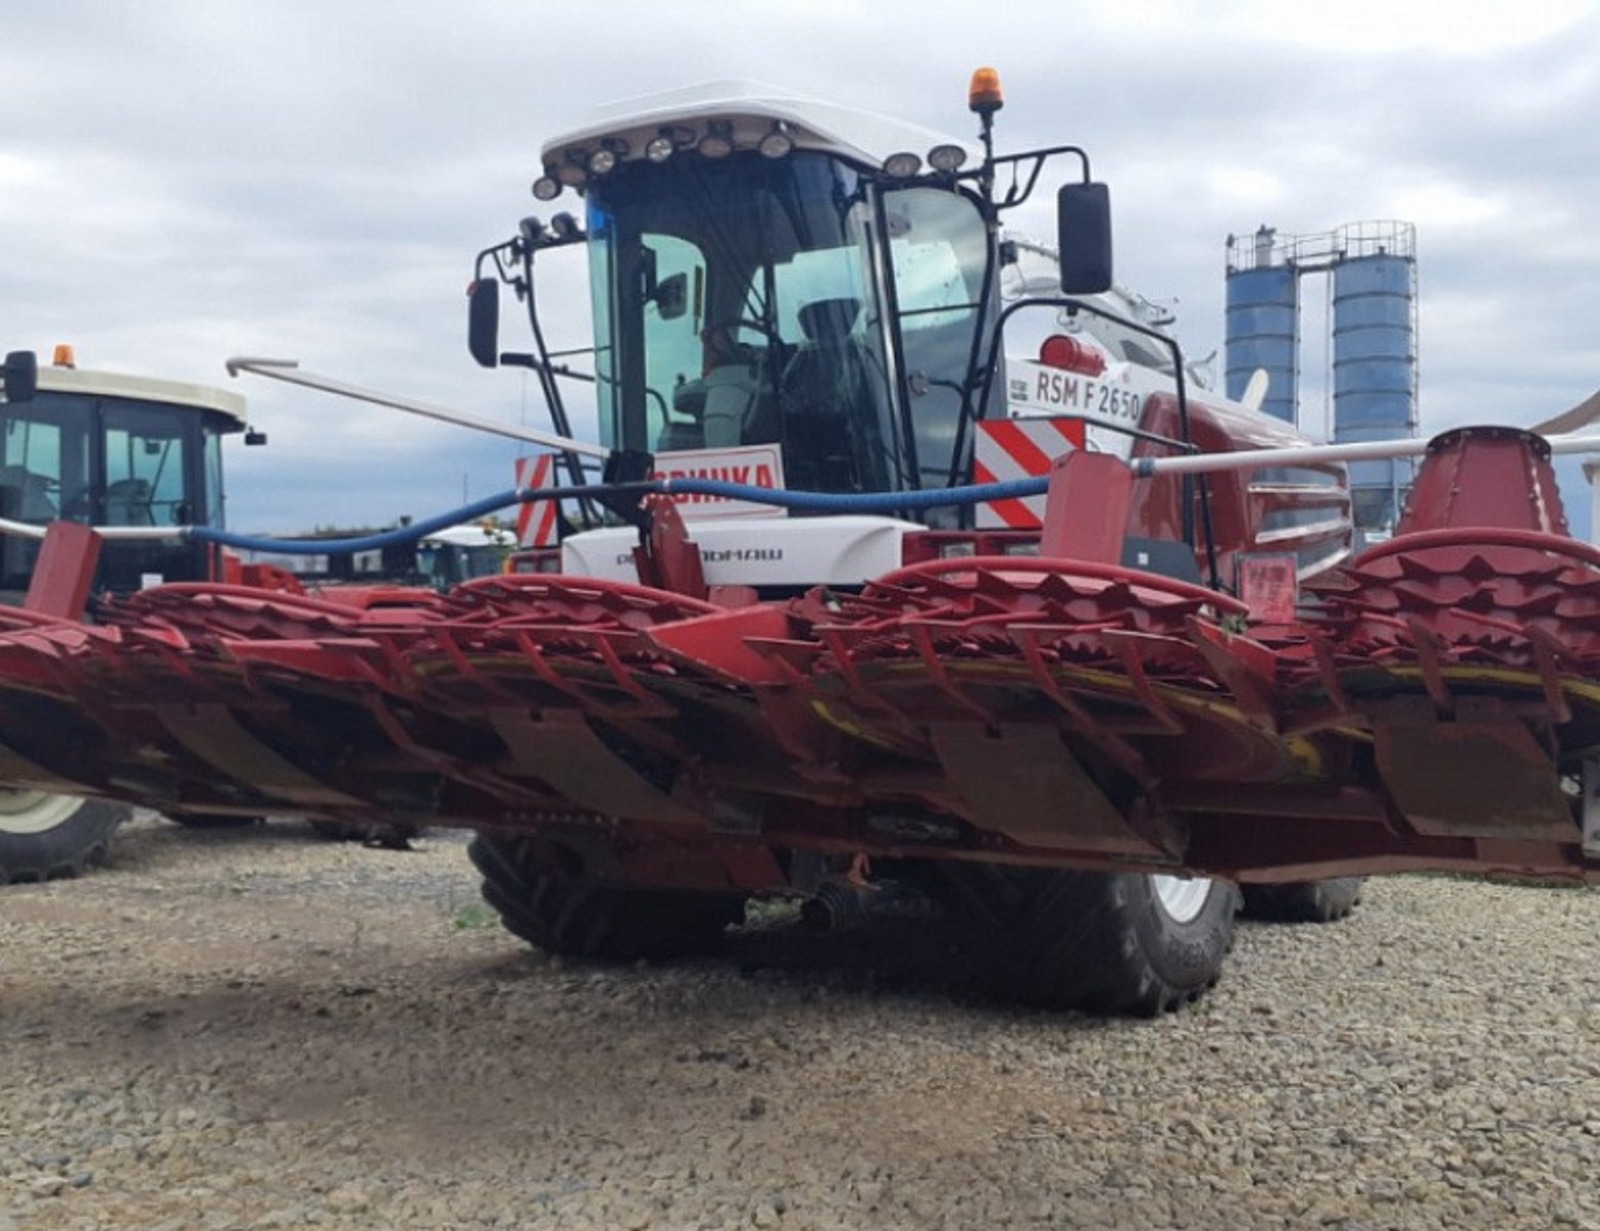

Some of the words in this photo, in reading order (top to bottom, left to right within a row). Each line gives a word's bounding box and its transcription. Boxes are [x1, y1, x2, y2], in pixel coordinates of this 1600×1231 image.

[1037, 371, 1078, 407] RSM
[1084, 382, 1096, 409] F
[1098, 385, 1140, 420] 2650
